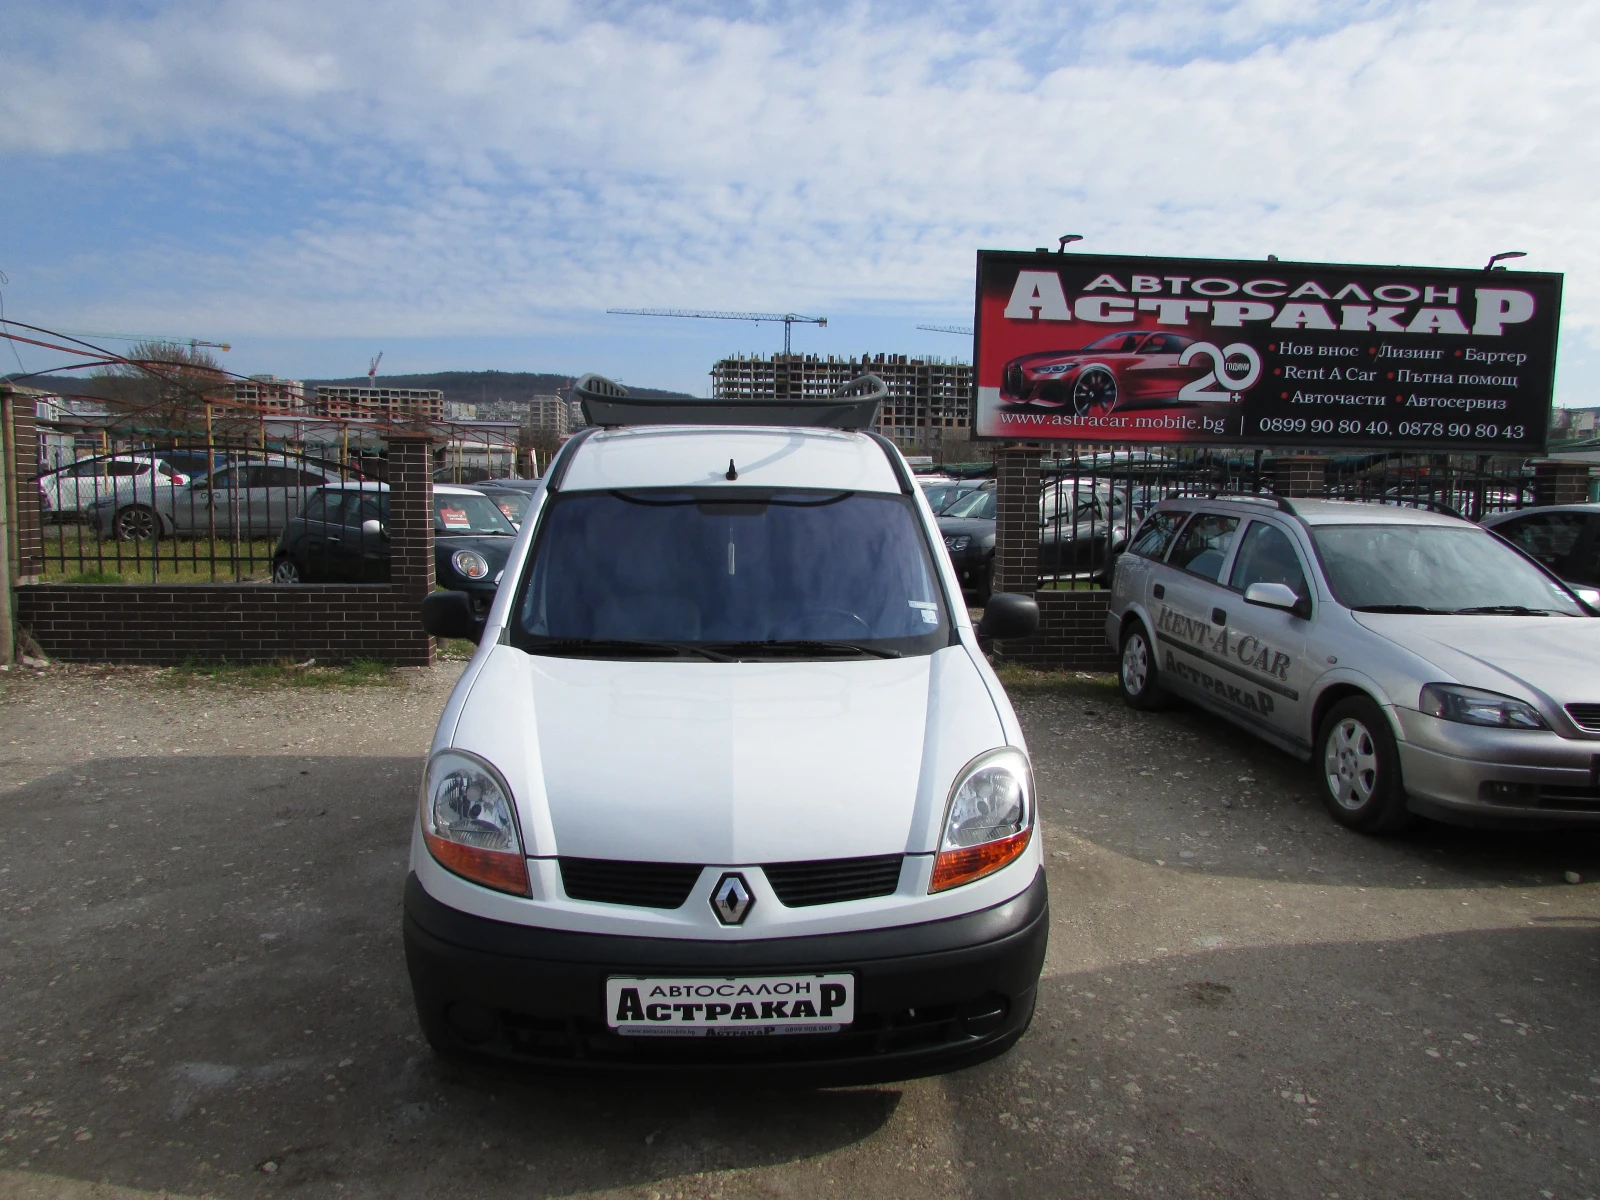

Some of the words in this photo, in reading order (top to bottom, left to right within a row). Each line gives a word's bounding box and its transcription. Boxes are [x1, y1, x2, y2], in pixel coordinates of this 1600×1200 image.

[1082, 274, 1458, 304] АВТОСАЛОН
[1003, 270, 1535, 337] АСТРАКАР
[1279, 341, 1313, 355] Нов
[1317, 345, 1359, 357] внос
[1378, 345, 1444, 360] Лизинг
[1464, 348, 1528, 366] Бартер
[1284, 365, 1325, 380] Rent
[1328, 367, 1342, 380] A
[1345, 367, 1377, 381] Car
[1397, 369, 1454, 384] Пътна
[1458, 374, 1519, 389] помощ
[1290, 390, 1387, 406] Авточасти
[1405, 394, 1507, 412] Автосервиз
[1000, 413, 1225, 433] www.astracar.mobile.bg
[1259, 418, 1306, 432] 0899
[1310, 419, 1333, 433] 90
[1338, 420, 1361, 434] 80
[1398, 421, 1443, 437] 0878
[1448, 423, 1471, 437] 90
[1474, 424, 1498, 438] 80
[1501, 425, 1525, 439] 43
[649, 982, 811, 998] АВТОСАЛОН
[616, 983, 847, 1022] АСТРАКАР
